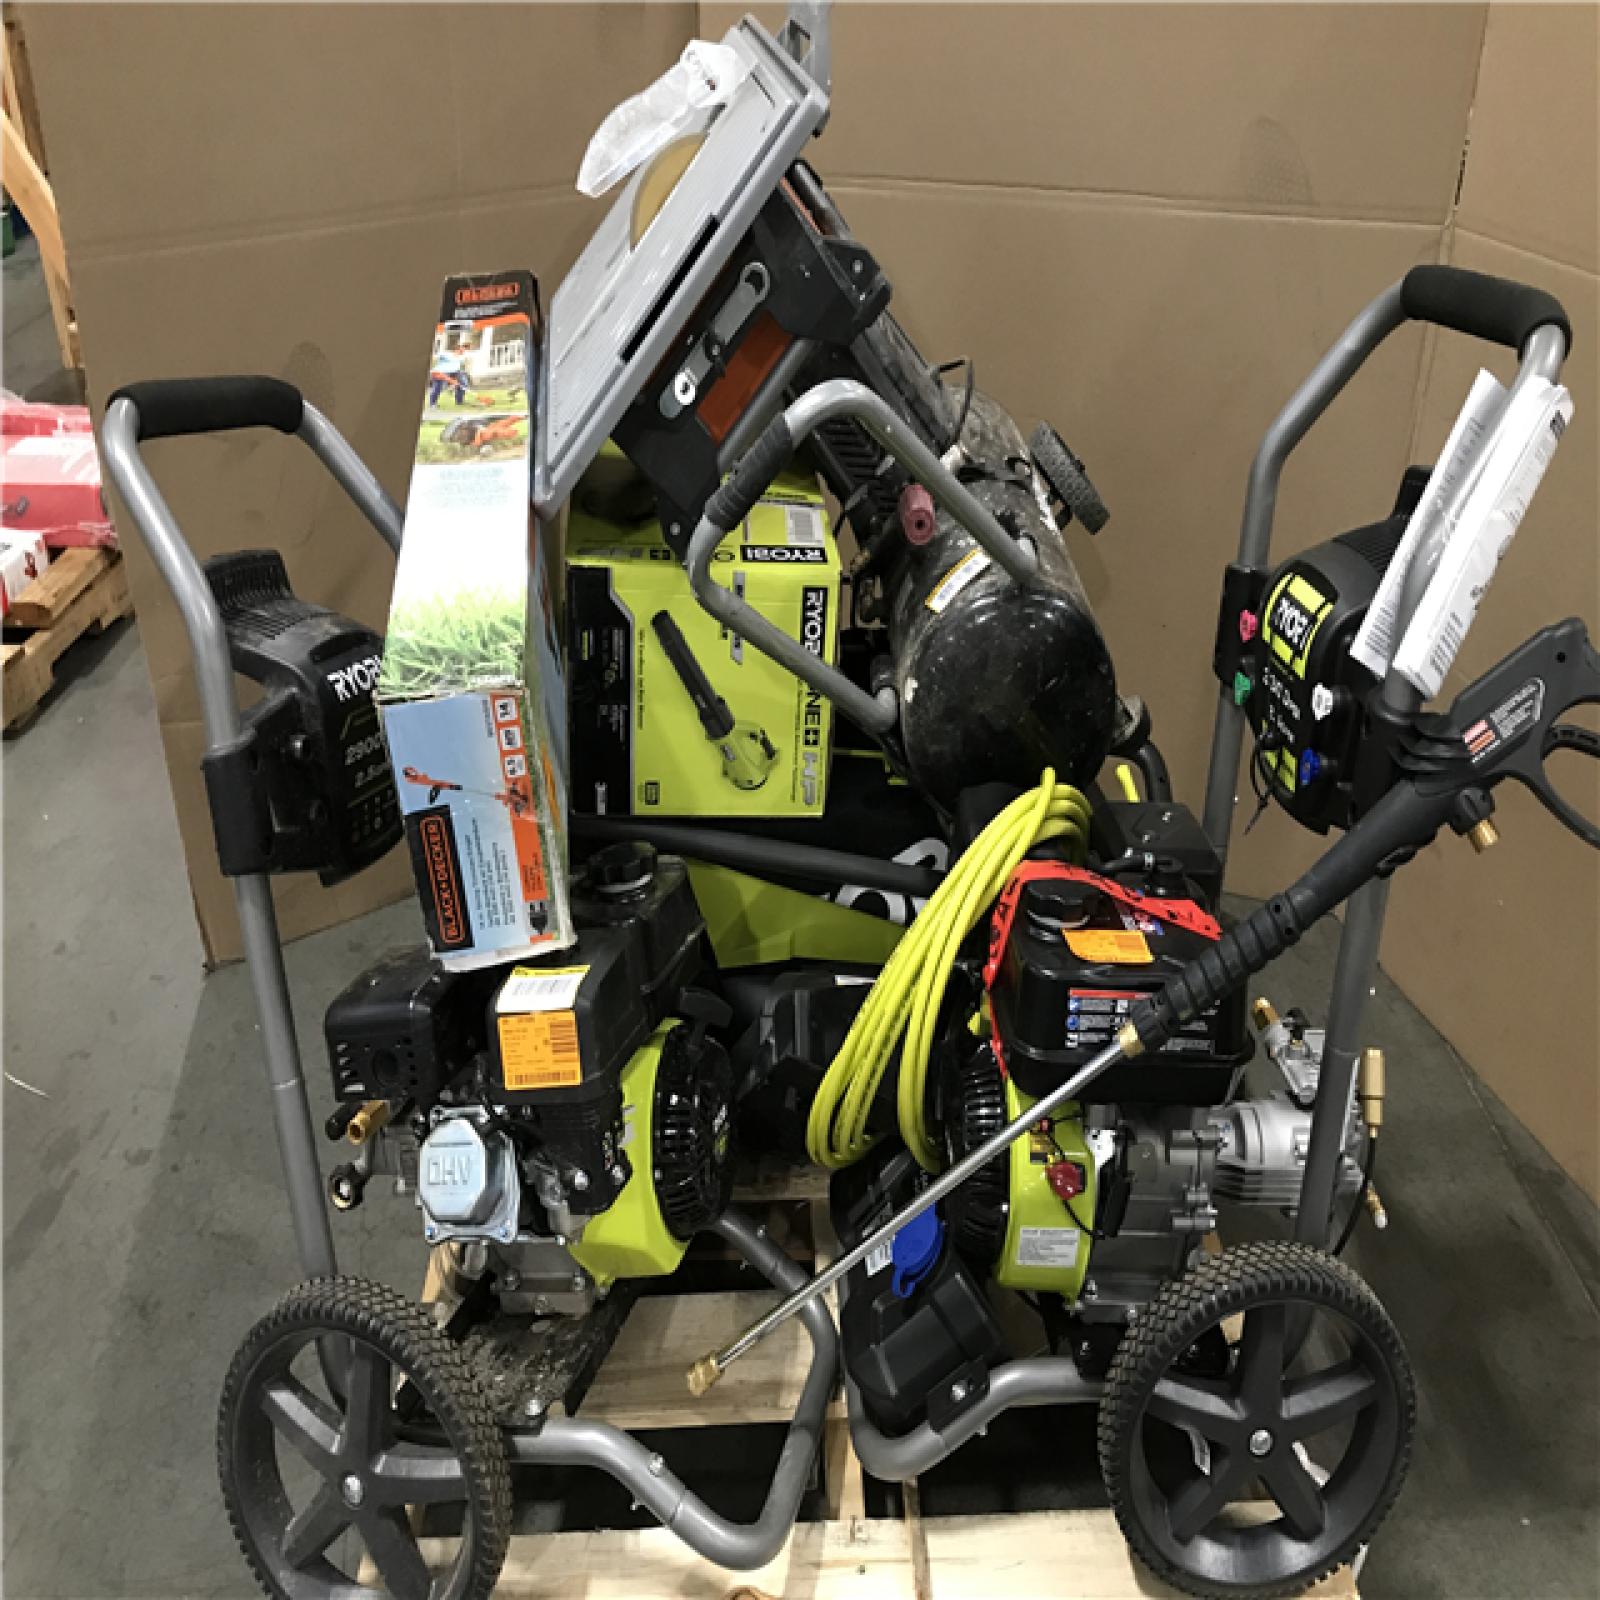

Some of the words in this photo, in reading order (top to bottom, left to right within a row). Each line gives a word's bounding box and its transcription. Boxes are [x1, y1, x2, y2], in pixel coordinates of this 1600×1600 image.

[745, 546, 824, 561] RYOBI
[803, 589, 825, 657] RYOB
[326, 654, 382, 703] RYOB
